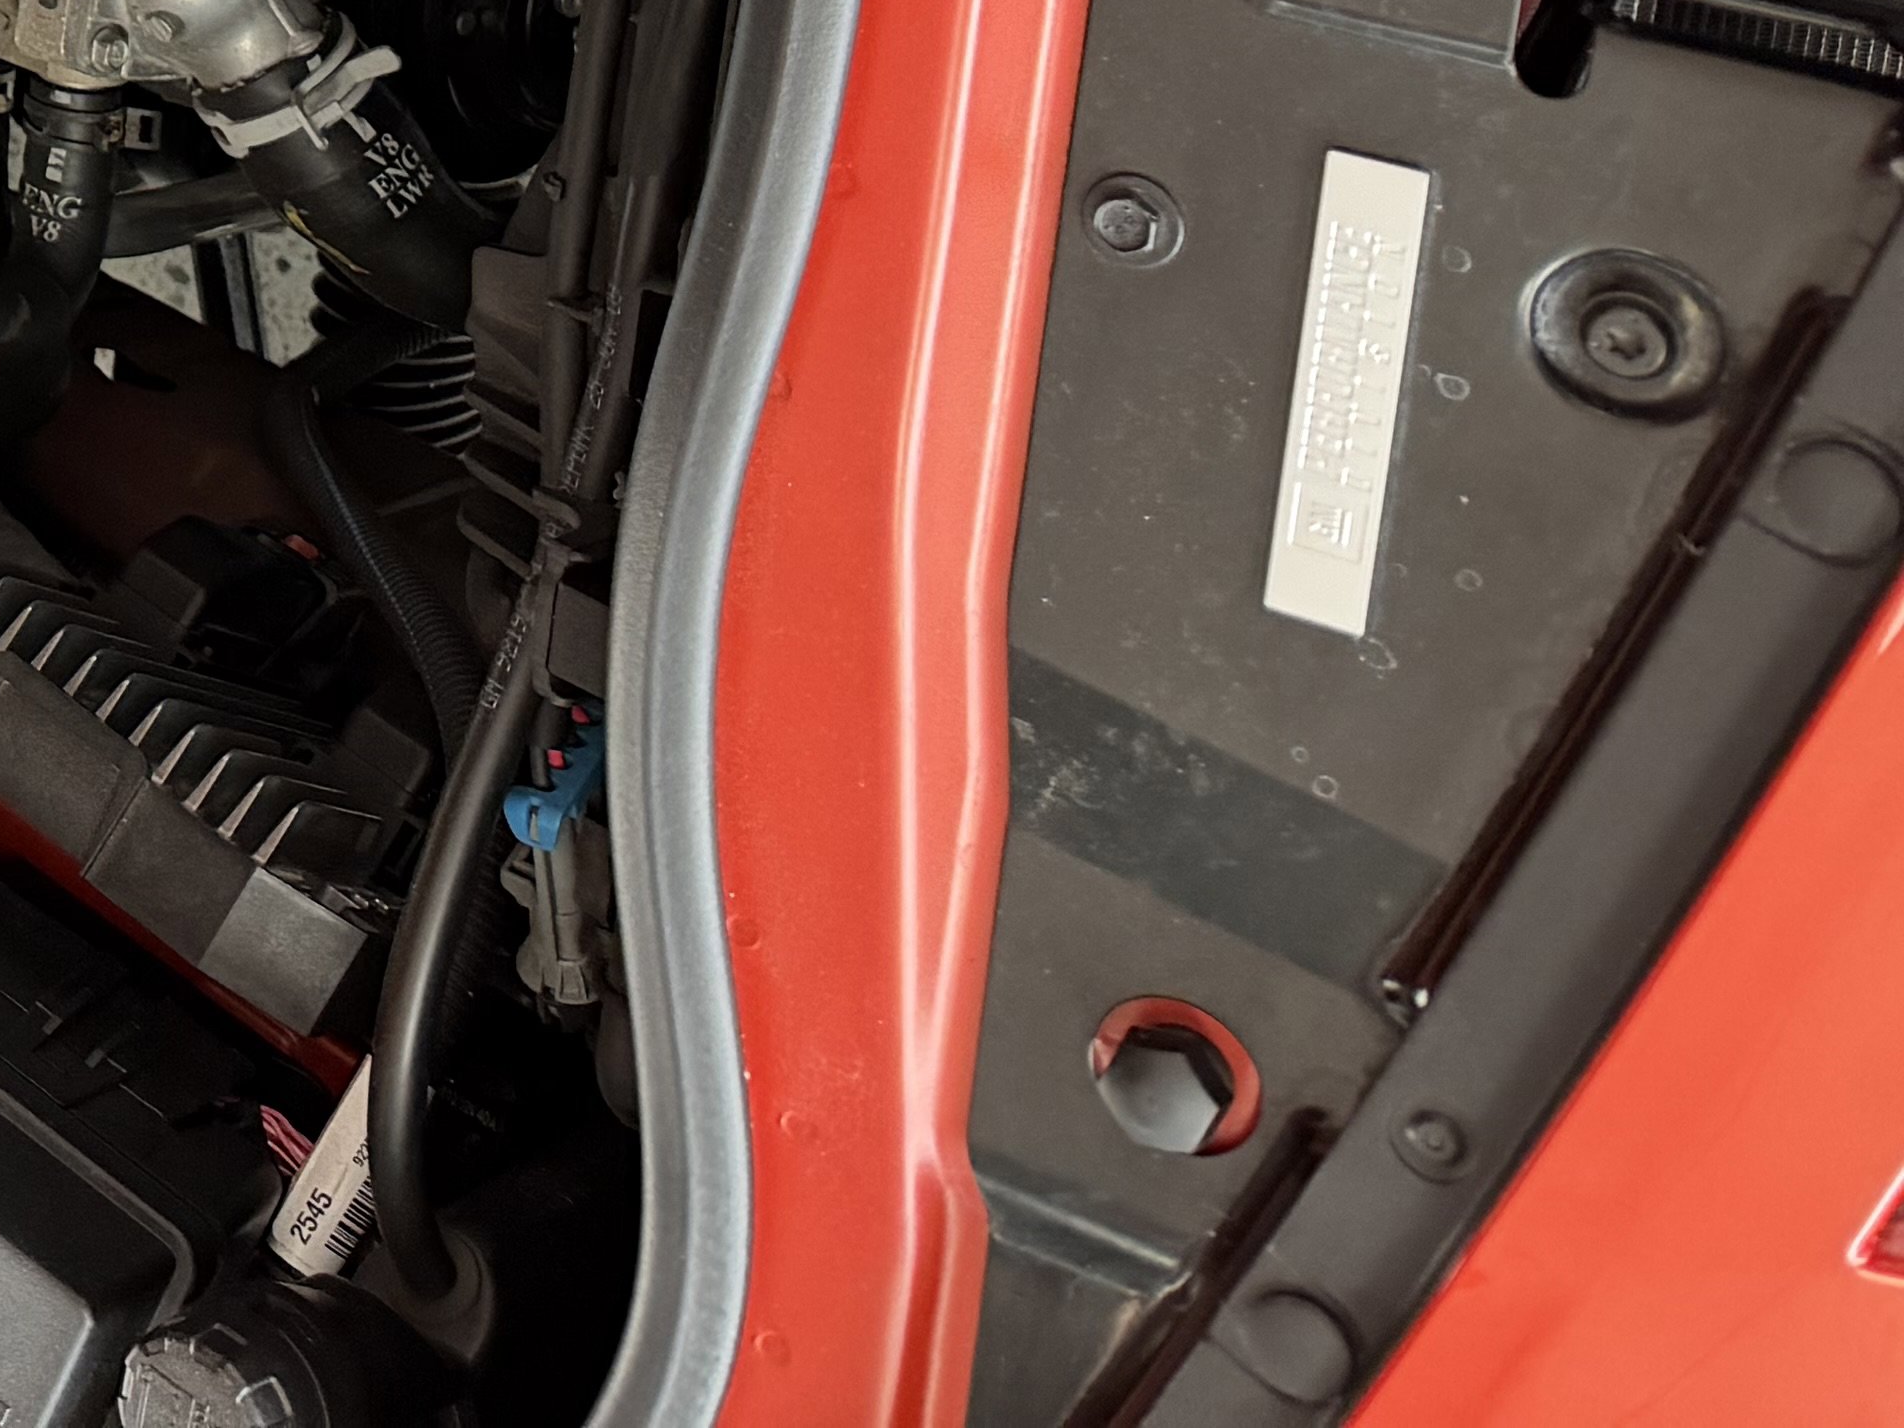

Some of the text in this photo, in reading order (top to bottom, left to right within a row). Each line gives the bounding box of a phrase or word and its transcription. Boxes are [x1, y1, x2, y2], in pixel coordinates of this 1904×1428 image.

[363, 132, 400, 167] V8
[368, 144, 421, 200] ENG
[22, 182, 83, 219] ENG
[385, 164, 435, 219] LWR
[30, 214, 62, 242] V8
[352, 1137, 371, 1168] 922
[288, 1188, 334, 1248] 2545
